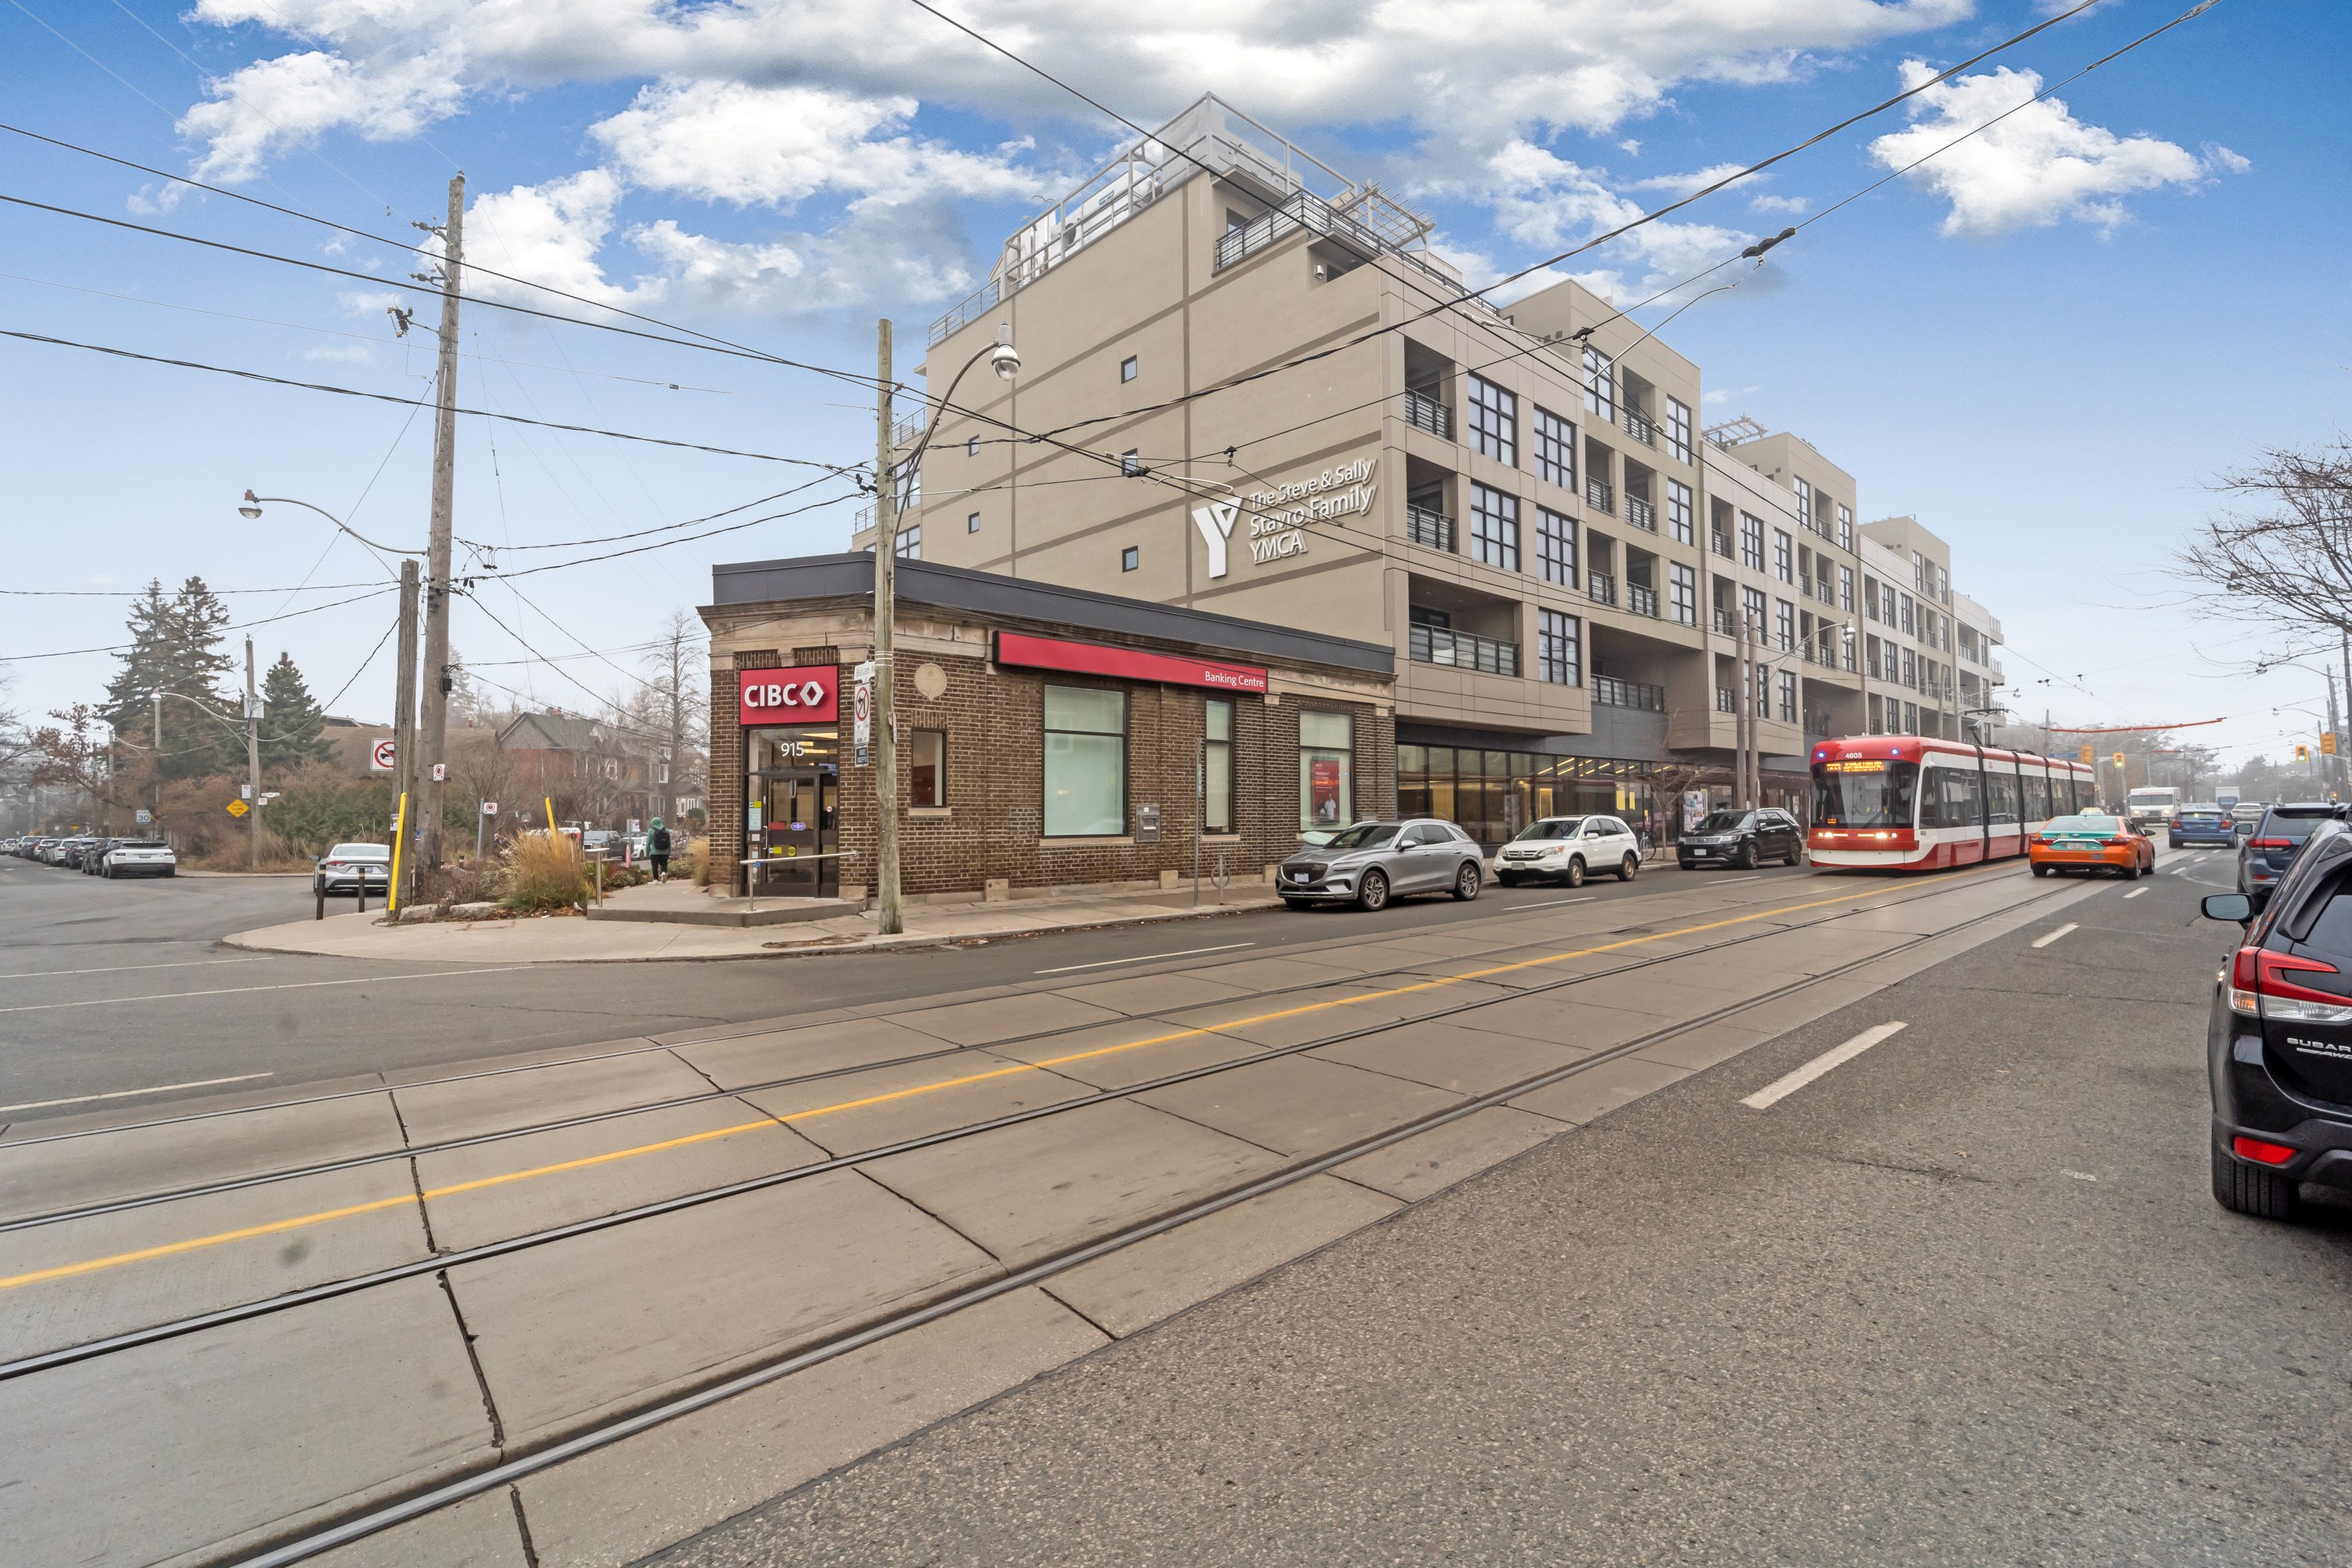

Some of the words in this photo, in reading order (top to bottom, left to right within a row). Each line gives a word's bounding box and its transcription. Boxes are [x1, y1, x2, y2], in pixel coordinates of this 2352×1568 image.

[1250, 491, 1276, 509] The
[1279, 479, 1317, 501] Steve
[1321, 471, 1332, 488] &
[1336, 460, 1372, 484] Sally
[1250, 508, 1304, 536] Stavro
[1310, 485, 1372, 518] Family
[1250, 532, 1303, 561] YMCA
[1205, 670, 1236, 687] Banking
[1239, 675, 1264, 687] Centre
[744, 683, 798, 707] CIBC
[781, 742, 804, 757] 915
